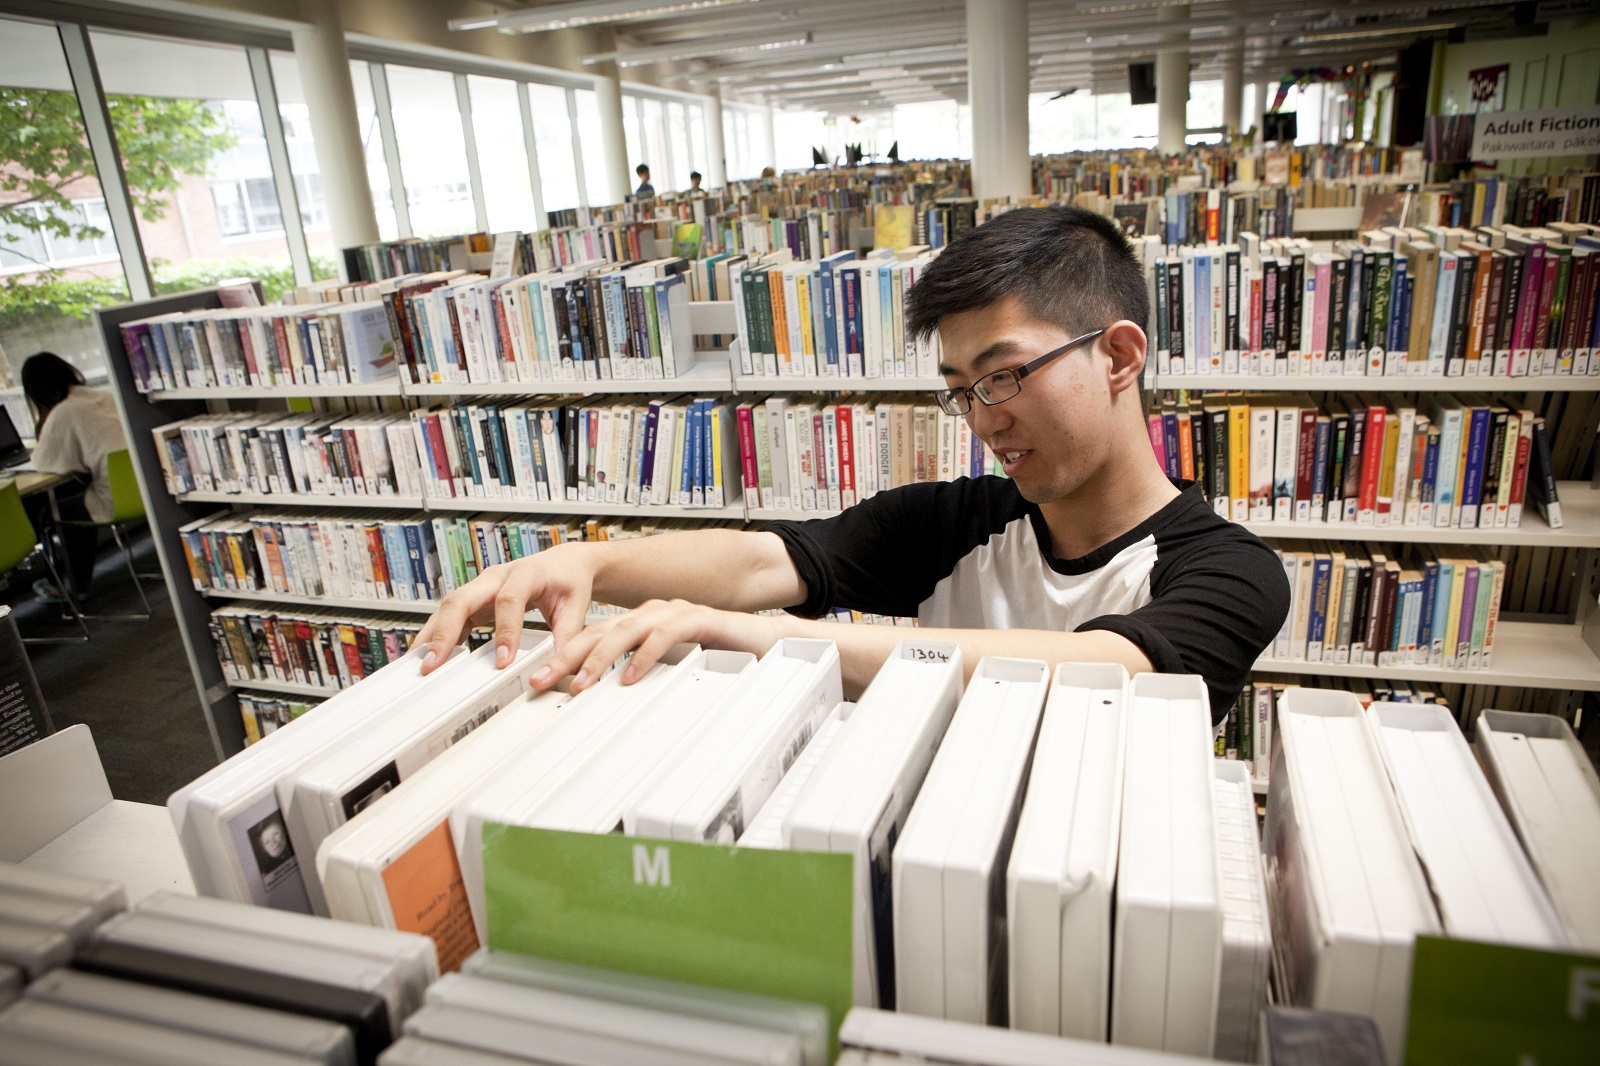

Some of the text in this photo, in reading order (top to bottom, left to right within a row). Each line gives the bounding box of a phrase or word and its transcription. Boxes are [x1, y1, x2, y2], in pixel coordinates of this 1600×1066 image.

[1484, 114, 1600, 136] Adult Fiction
[840, 420, 848, 442] JAMES
[940, 422, 951, 465] Bomber Boys
[805, 450, 813, 477] BROTHERS
[880, 443, 889, 475] DODGER
[928, 454, 936, 482] DAMBU
[633, 844, 671, 887] M
